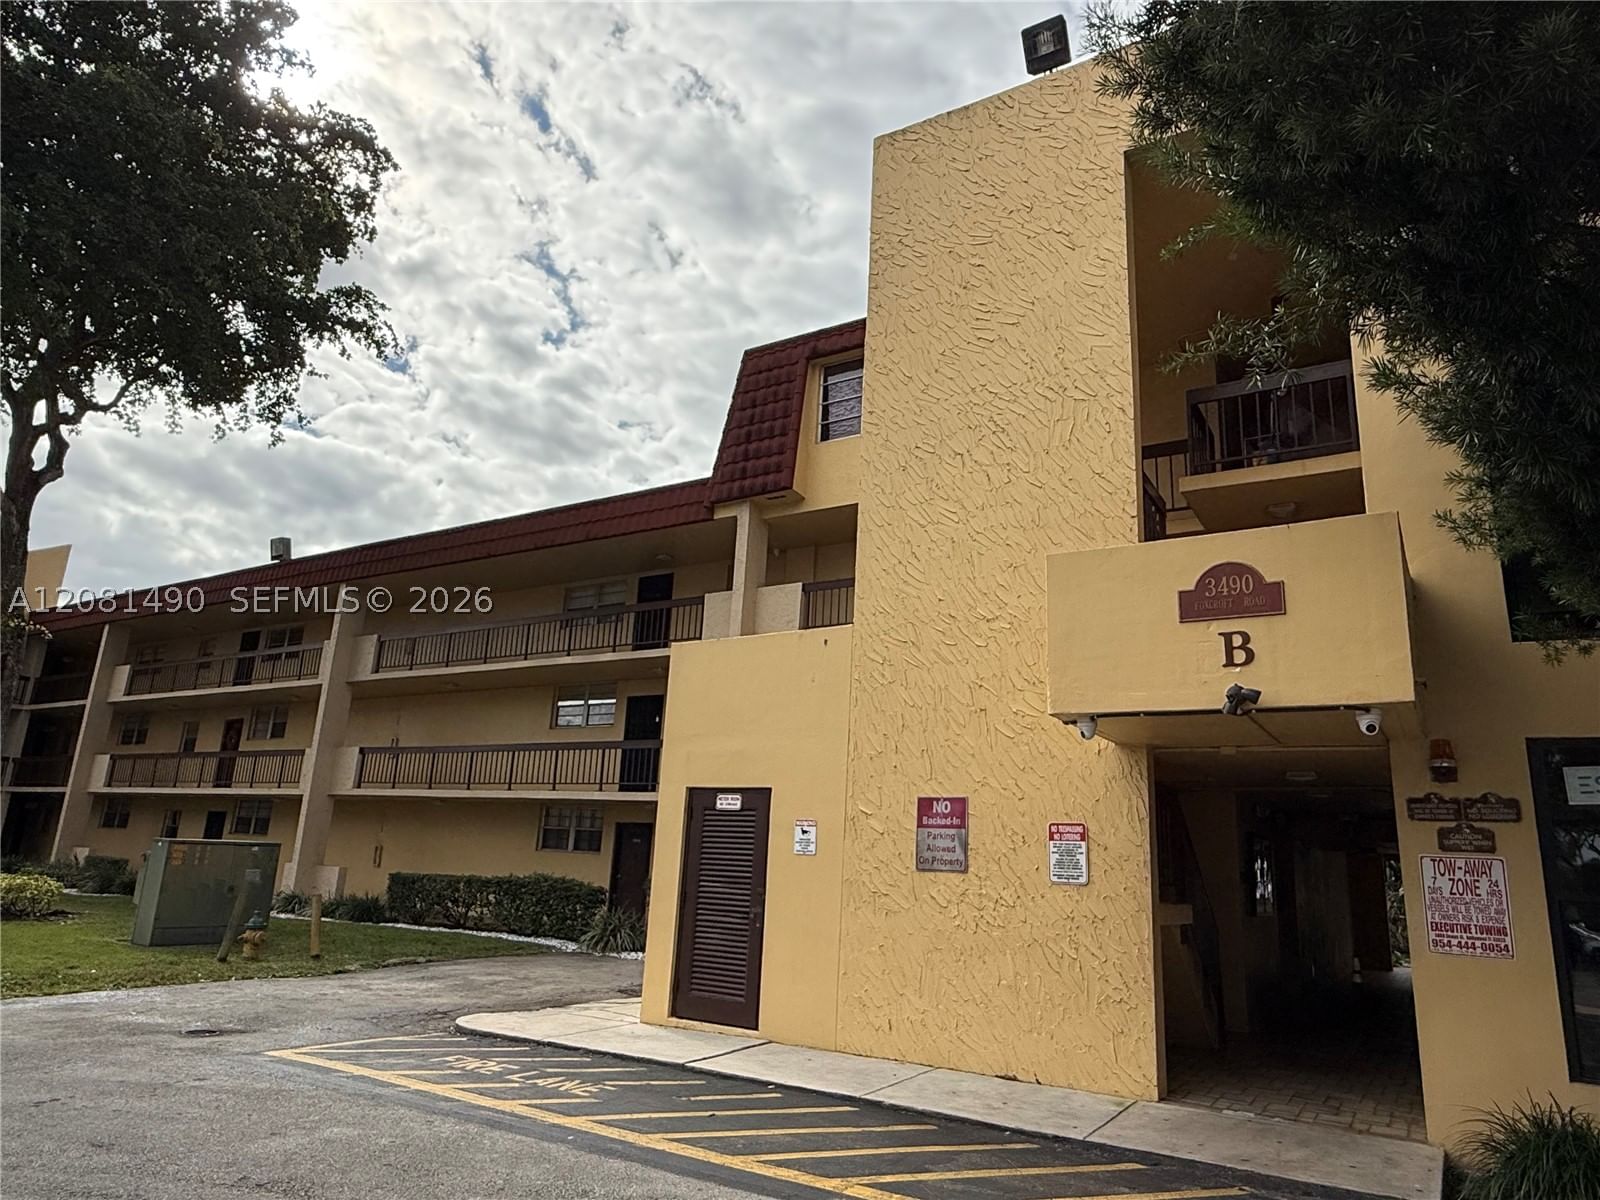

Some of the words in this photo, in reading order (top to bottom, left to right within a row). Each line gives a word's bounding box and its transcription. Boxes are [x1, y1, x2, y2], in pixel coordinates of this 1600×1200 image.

[1204, 574, 1254, 597] 3490
[1195, 598, 1233, 610] FOXCROFT
[1243, 596, 1266, 607] ROAD
[1217, 630, 1256, 668] B
[932, 800, 951, 814] NO
[922, 815, 961, 825] Backed-In
[926, 831, 956, 843] Parking
[926, 844, 956, 853] Allowed
[918, 855, 930, 865] On
[931, 856, 964, 868] Property
[1431, 876, 1437, 885] 7
[1487, 879, 1499, 889] 24
[1427, 885, 1443, 896] DAYS
[1448, 878, 1482, 897] ZONE
[1486, 889, 1503, 899] HRS
[1430, 921, 1473, 934] EXECUTIVE
[1474, 924, 1509, 937] TOWING
[1431, 938, 1510, 954] 954-444-0054
[430, 1055, 520, 1075] FIRE
[504, 1070, 618, 1096] LANE
